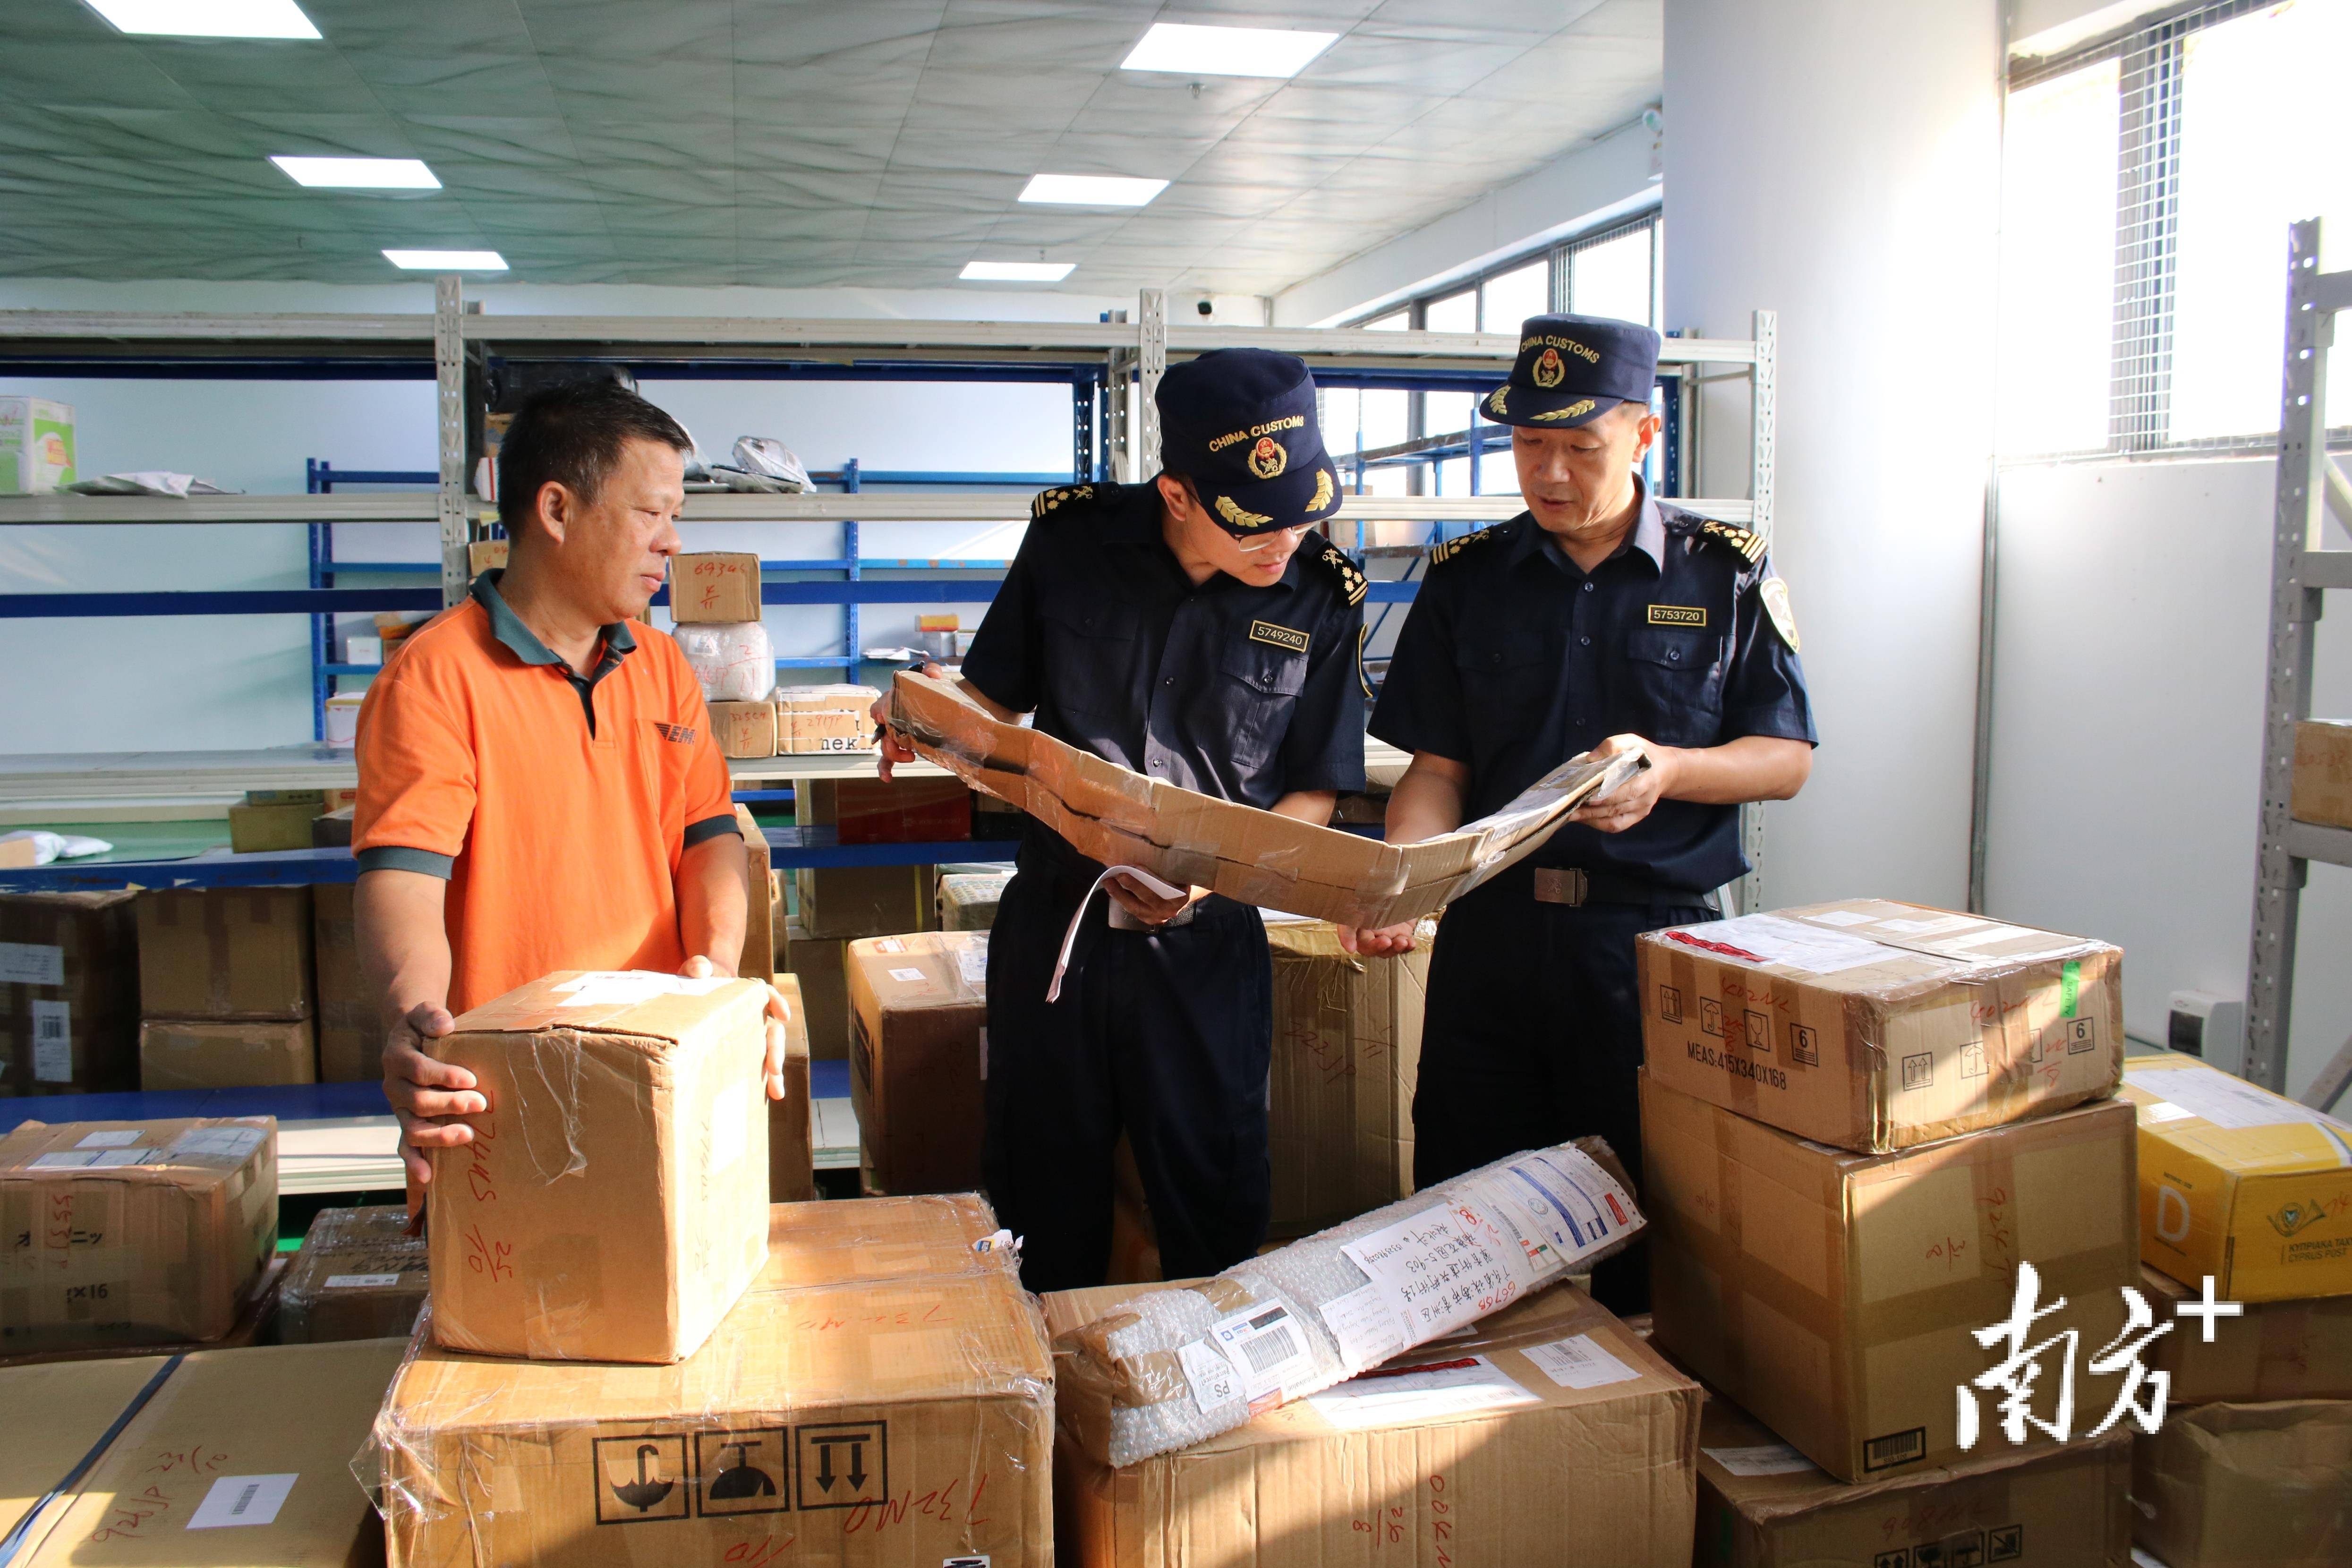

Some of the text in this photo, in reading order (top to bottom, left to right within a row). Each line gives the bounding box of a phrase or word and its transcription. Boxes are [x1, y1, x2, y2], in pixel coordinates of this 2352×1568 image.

[1521, 335, 1600, 363] CHINA CUSTOMS
[1209, 415, 1304, 452] CHINA CUSTOMS
[1653, 610, 1699, 621] 5753720
[1257, 626, 1302, 645] 5749240
[2064, 980, 2073, 1016] SAFETY
[1799, 1030, 1808, 1048] 6
[2076, 1022, 2085, 1039] 6
[2157, 1185, 2190, 1242] D
[2288, 1247, 2347, 1263] CYPRUS POST
[1214, 1380, 1230, 1398] PS
[1287, 1371, 1318, 1392] globalvalue
